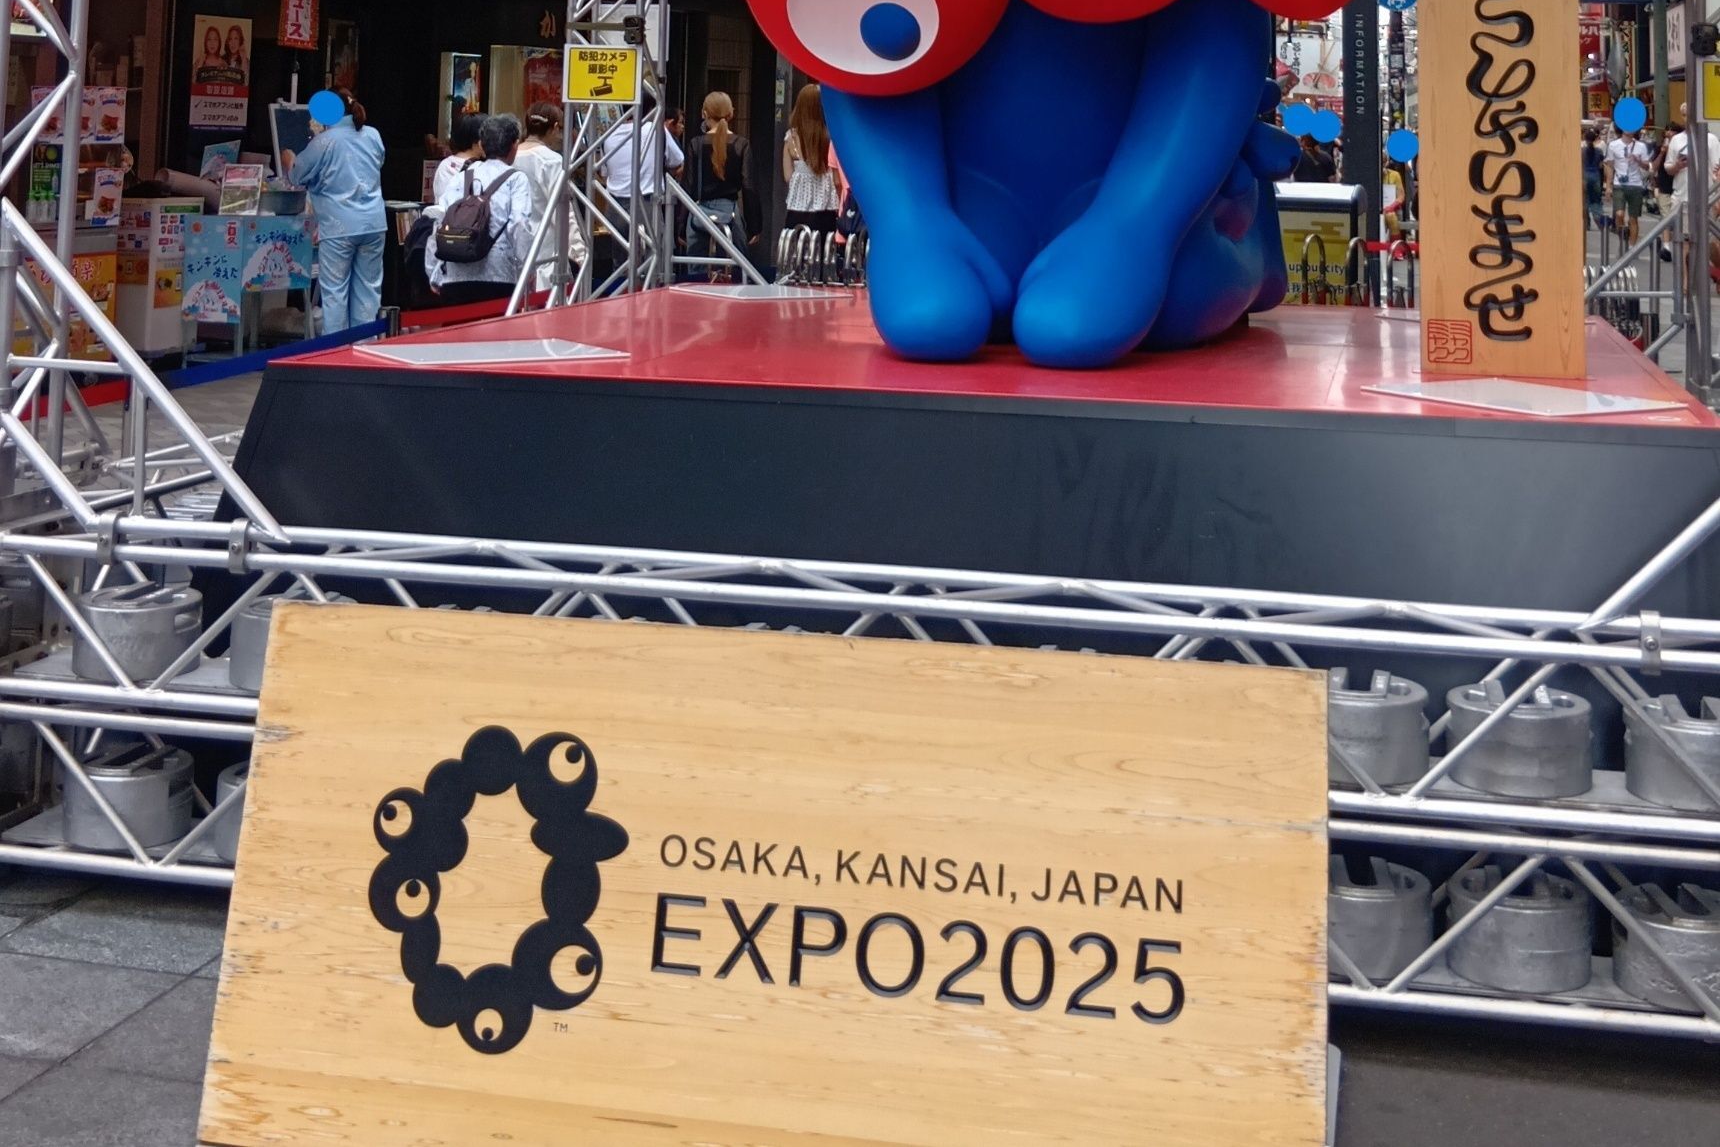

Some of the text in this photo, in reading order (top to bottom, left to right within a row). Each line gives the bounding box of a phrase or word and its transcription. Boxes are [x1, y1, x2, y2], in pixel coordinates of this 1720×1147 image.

[578, 51, 628, 62] 防犯カメラ
[588, 64, 618, 74] 撮影中
[1355, 14, 1365, 115] INFORMATION
[659, 834, 1184, 914] OSAKA, KANSAI, JAPAN
[651, 891, 1186, 1025] EXPO2025
[553, 1022, 568, 1032] TM
